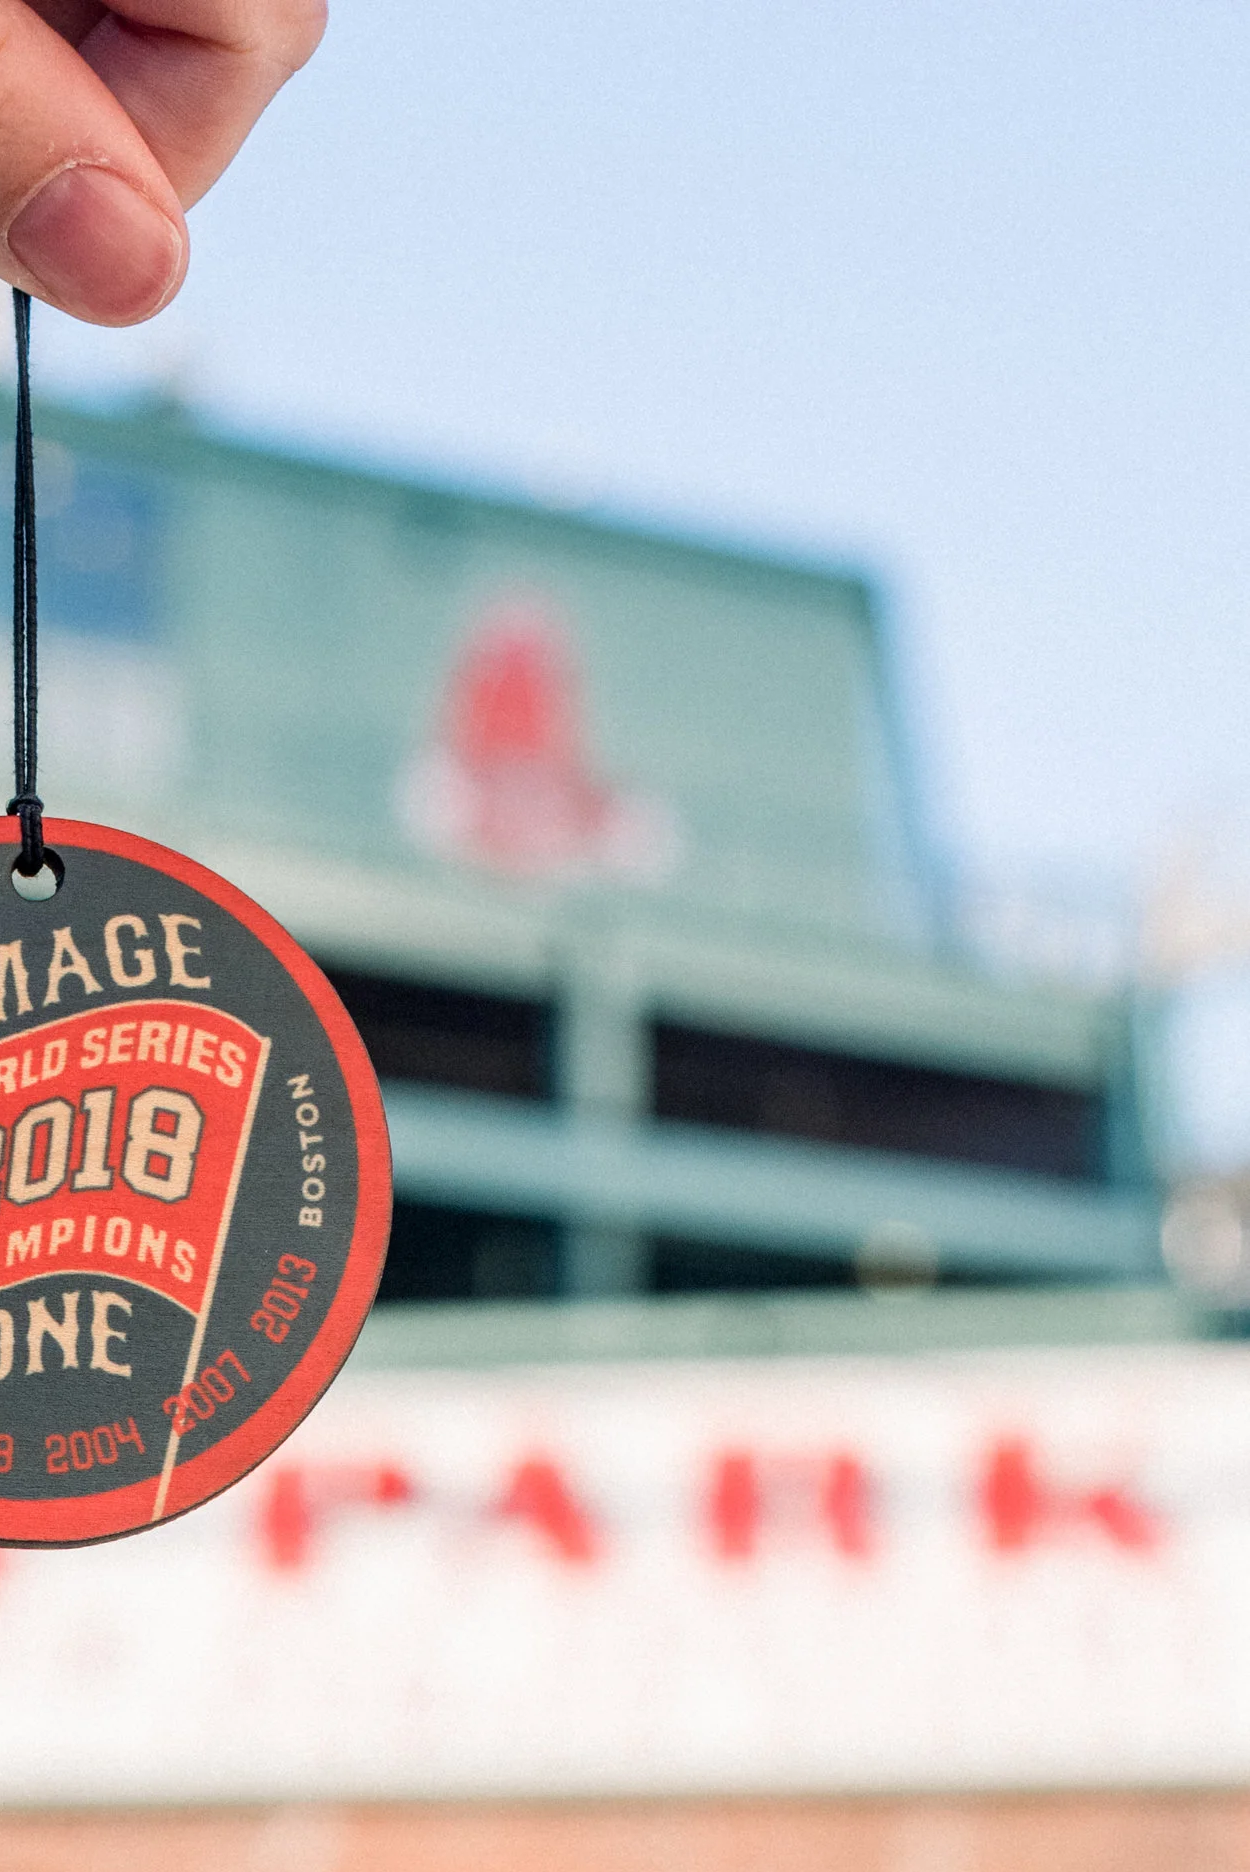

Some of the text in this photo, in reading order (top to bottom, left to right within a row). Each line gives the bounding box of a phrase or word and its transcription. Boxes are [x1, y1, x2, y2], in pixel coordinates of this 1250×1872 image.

[80, 1022, 247, 1089] SERIES
[287, 1074, 324, 1228] BOSTON
[45, 1418, 145, 1473] 2004
[161, 1348, 253, 1437] 2007
[249, 1252, 318, 1344] 2013
